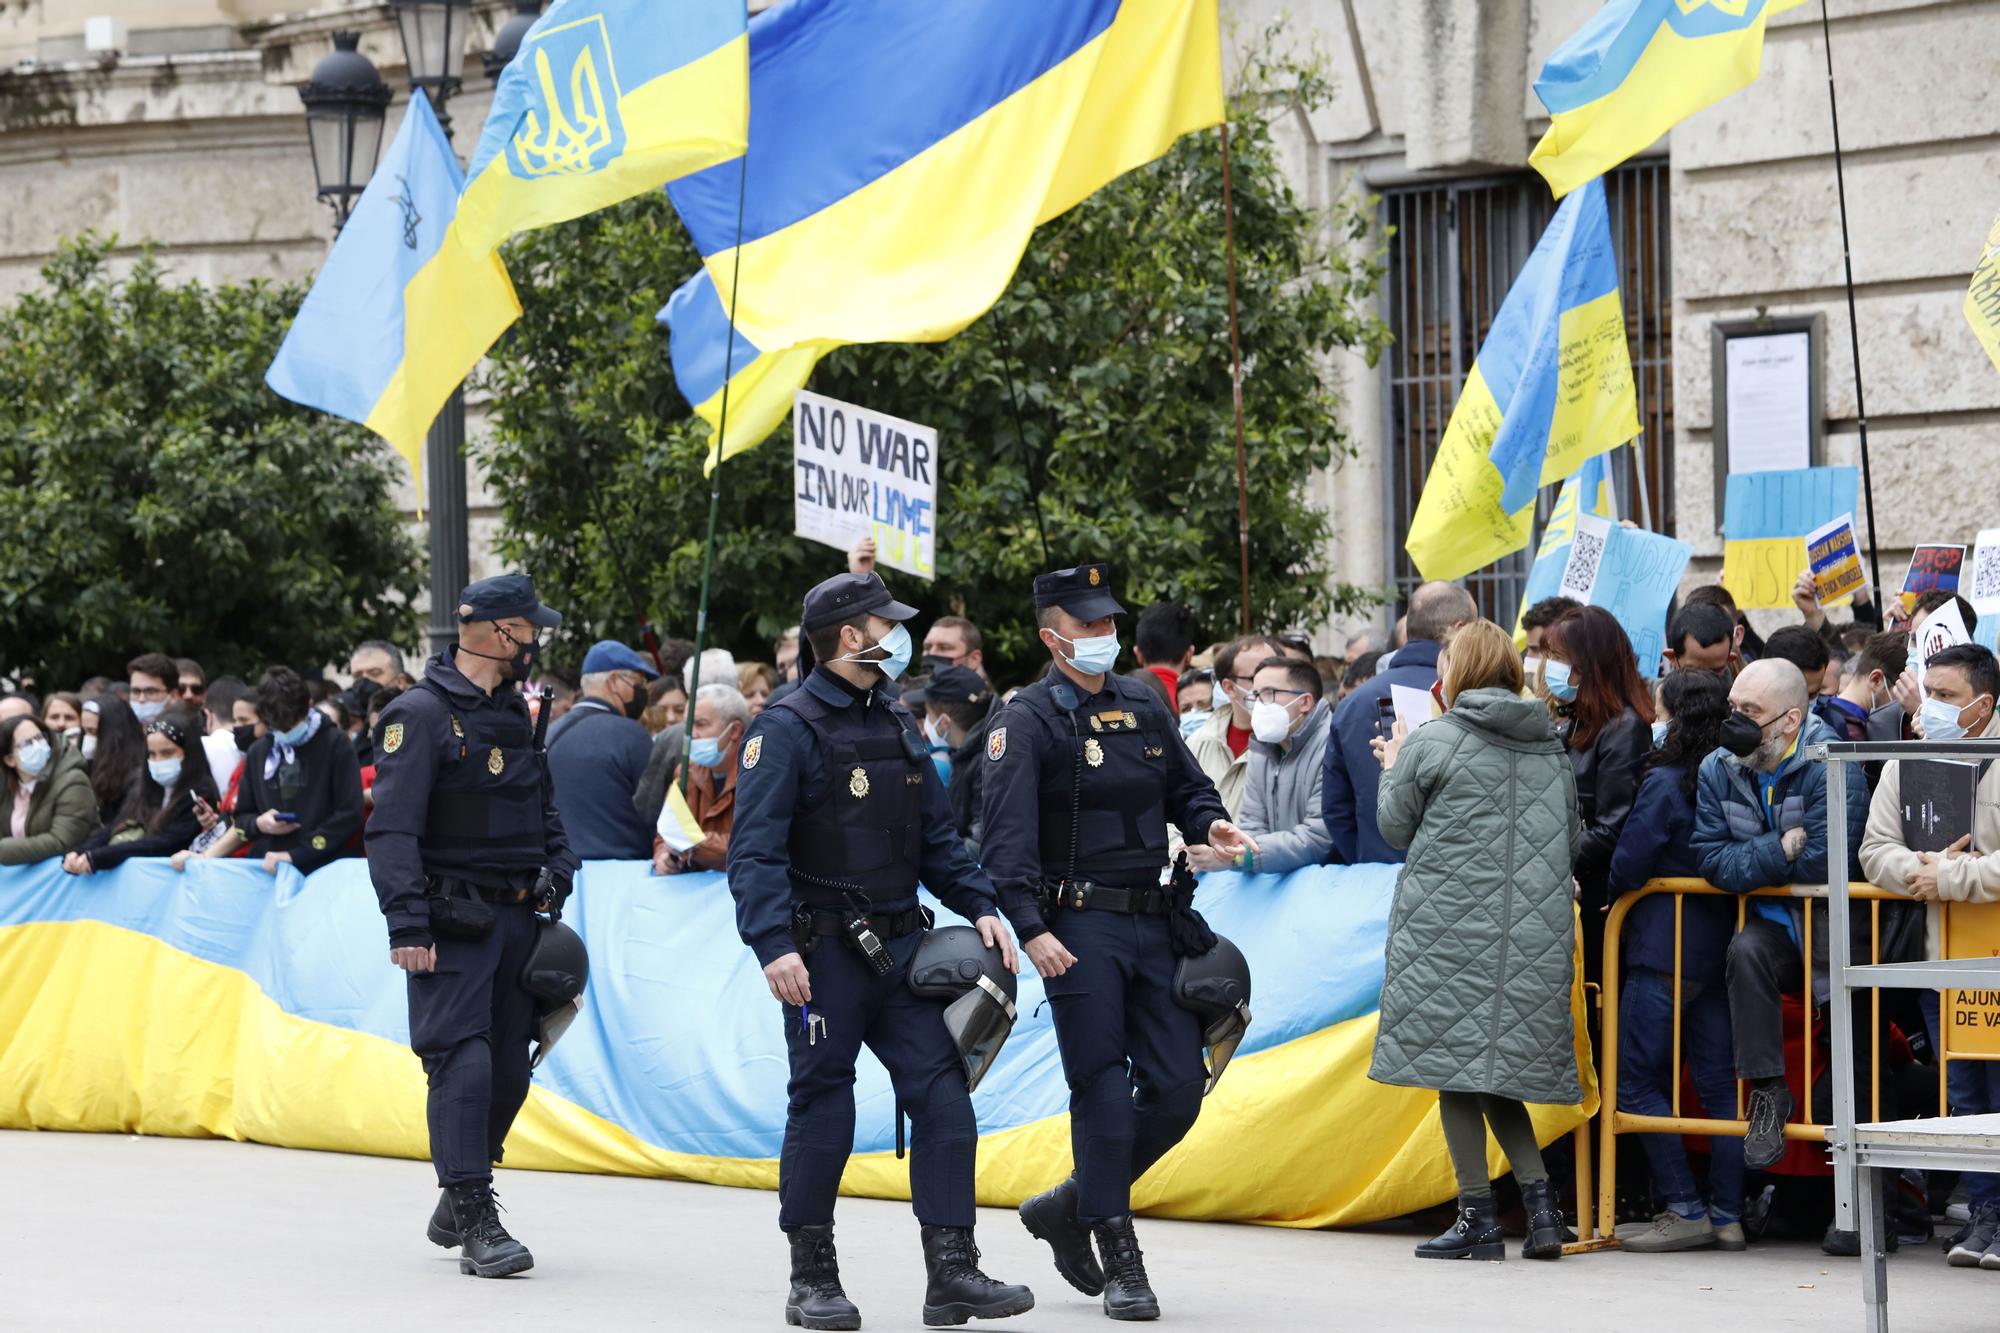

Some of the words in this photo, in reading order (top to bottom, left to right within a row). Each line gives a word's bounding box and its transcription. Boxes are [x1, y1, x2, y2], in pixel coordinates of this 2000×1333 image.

[800, 402, 845, 455] NO
[857, 419, 930, 485] WAR
[798, 459, 836, 509] IN
[841, 473, 869, 516] OUR
[1913, 549, 1961, 568] STOP
[1956, 1011, 1977, 1026] DE
